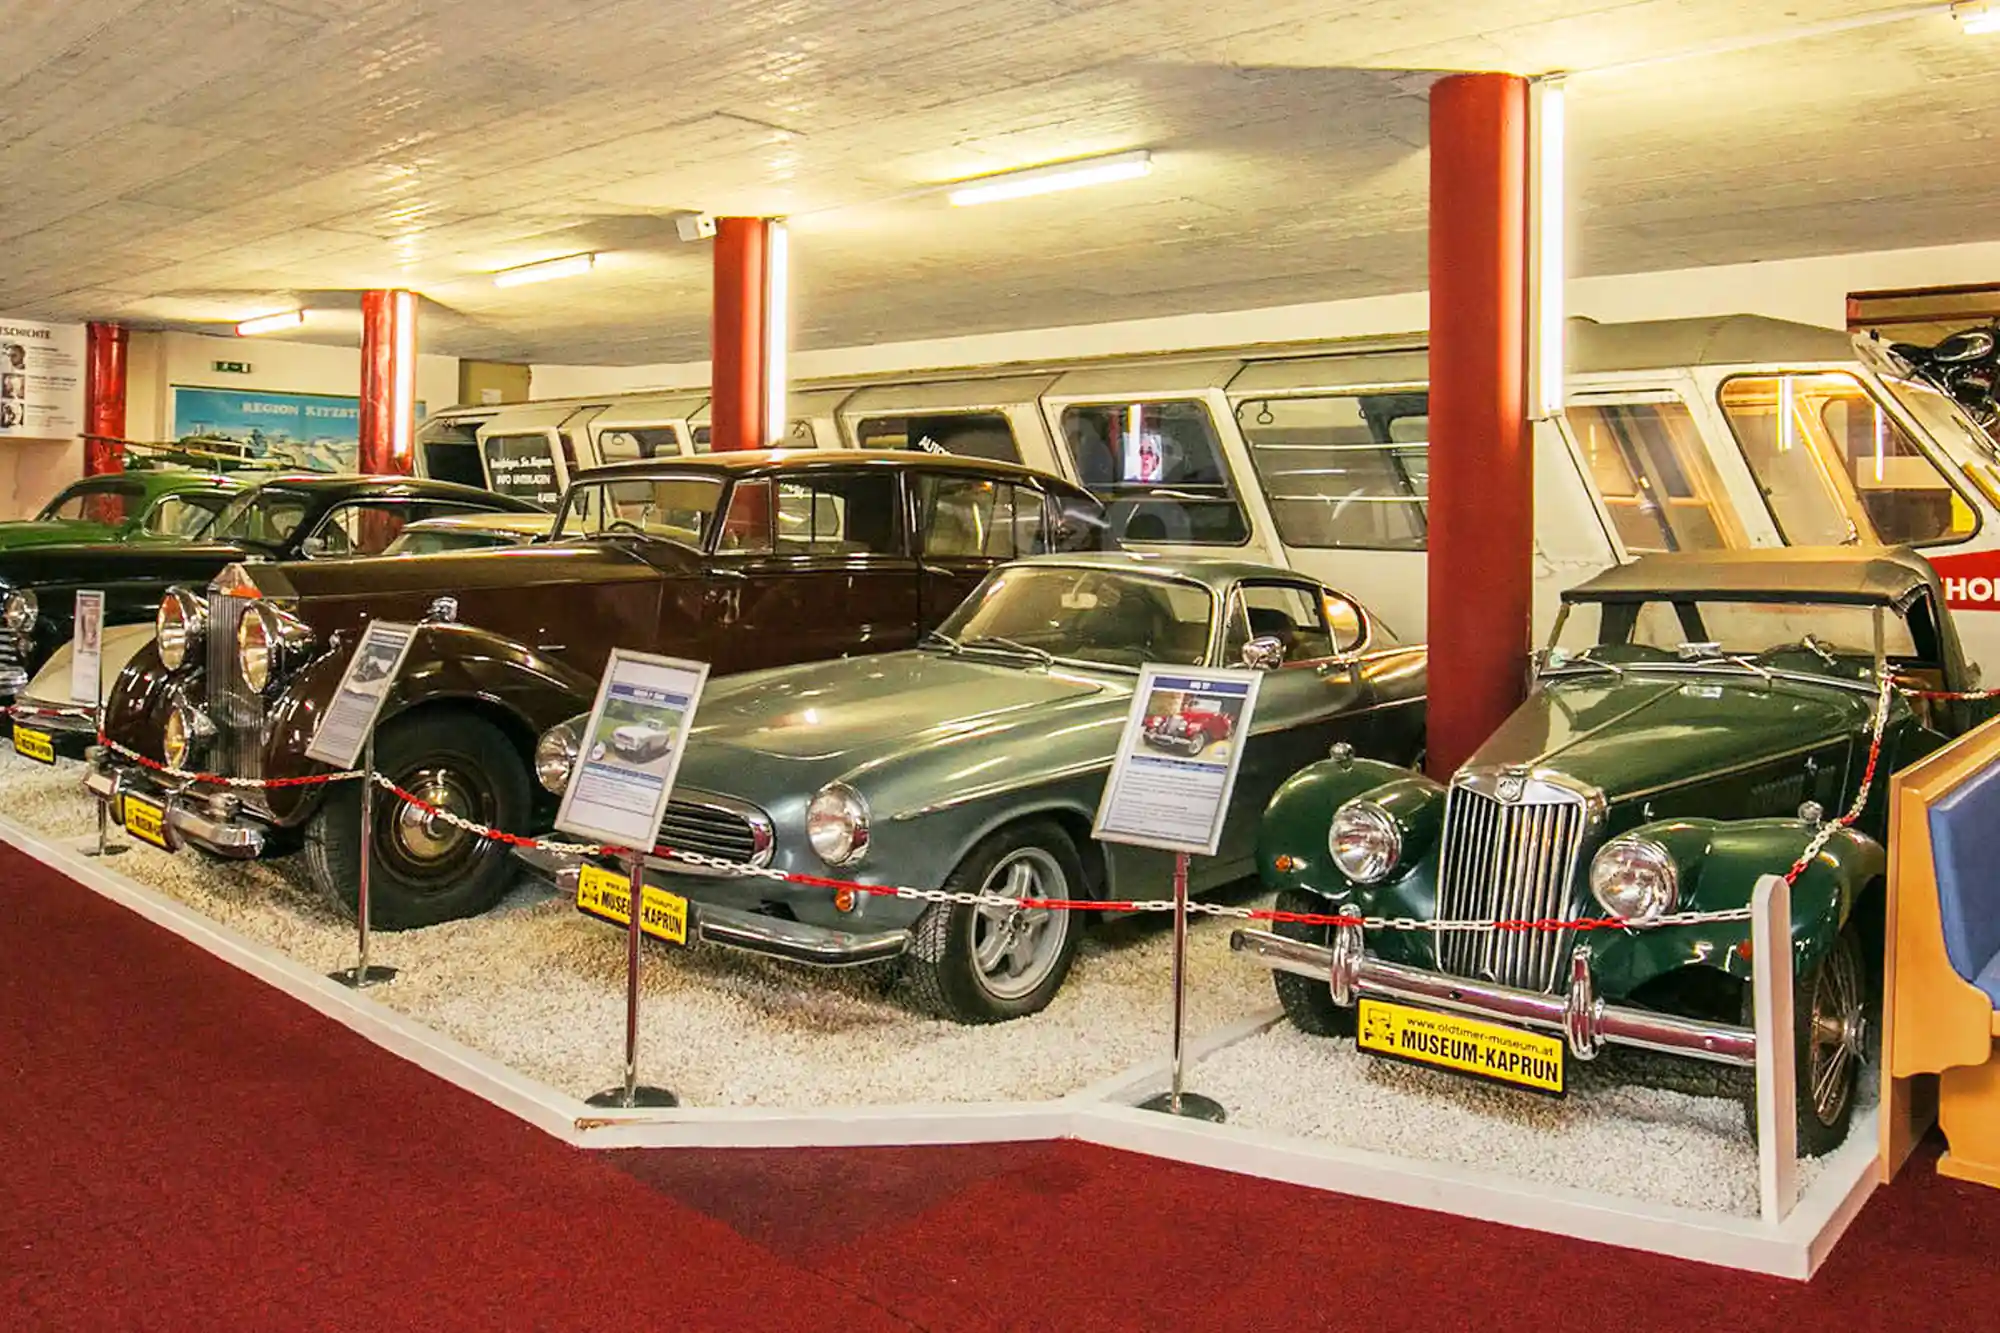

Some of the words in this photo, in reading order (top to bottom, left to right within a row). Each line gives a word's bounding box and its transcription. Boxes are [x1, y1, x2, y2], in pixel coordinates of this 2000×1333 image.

[242, 401, 298, 415] REGION
[1401, 1029, 1558, 1083] MUSEUM-KAPRUN
[1406, 1017, 1553, 1056] www.oldtimer-museum.at
